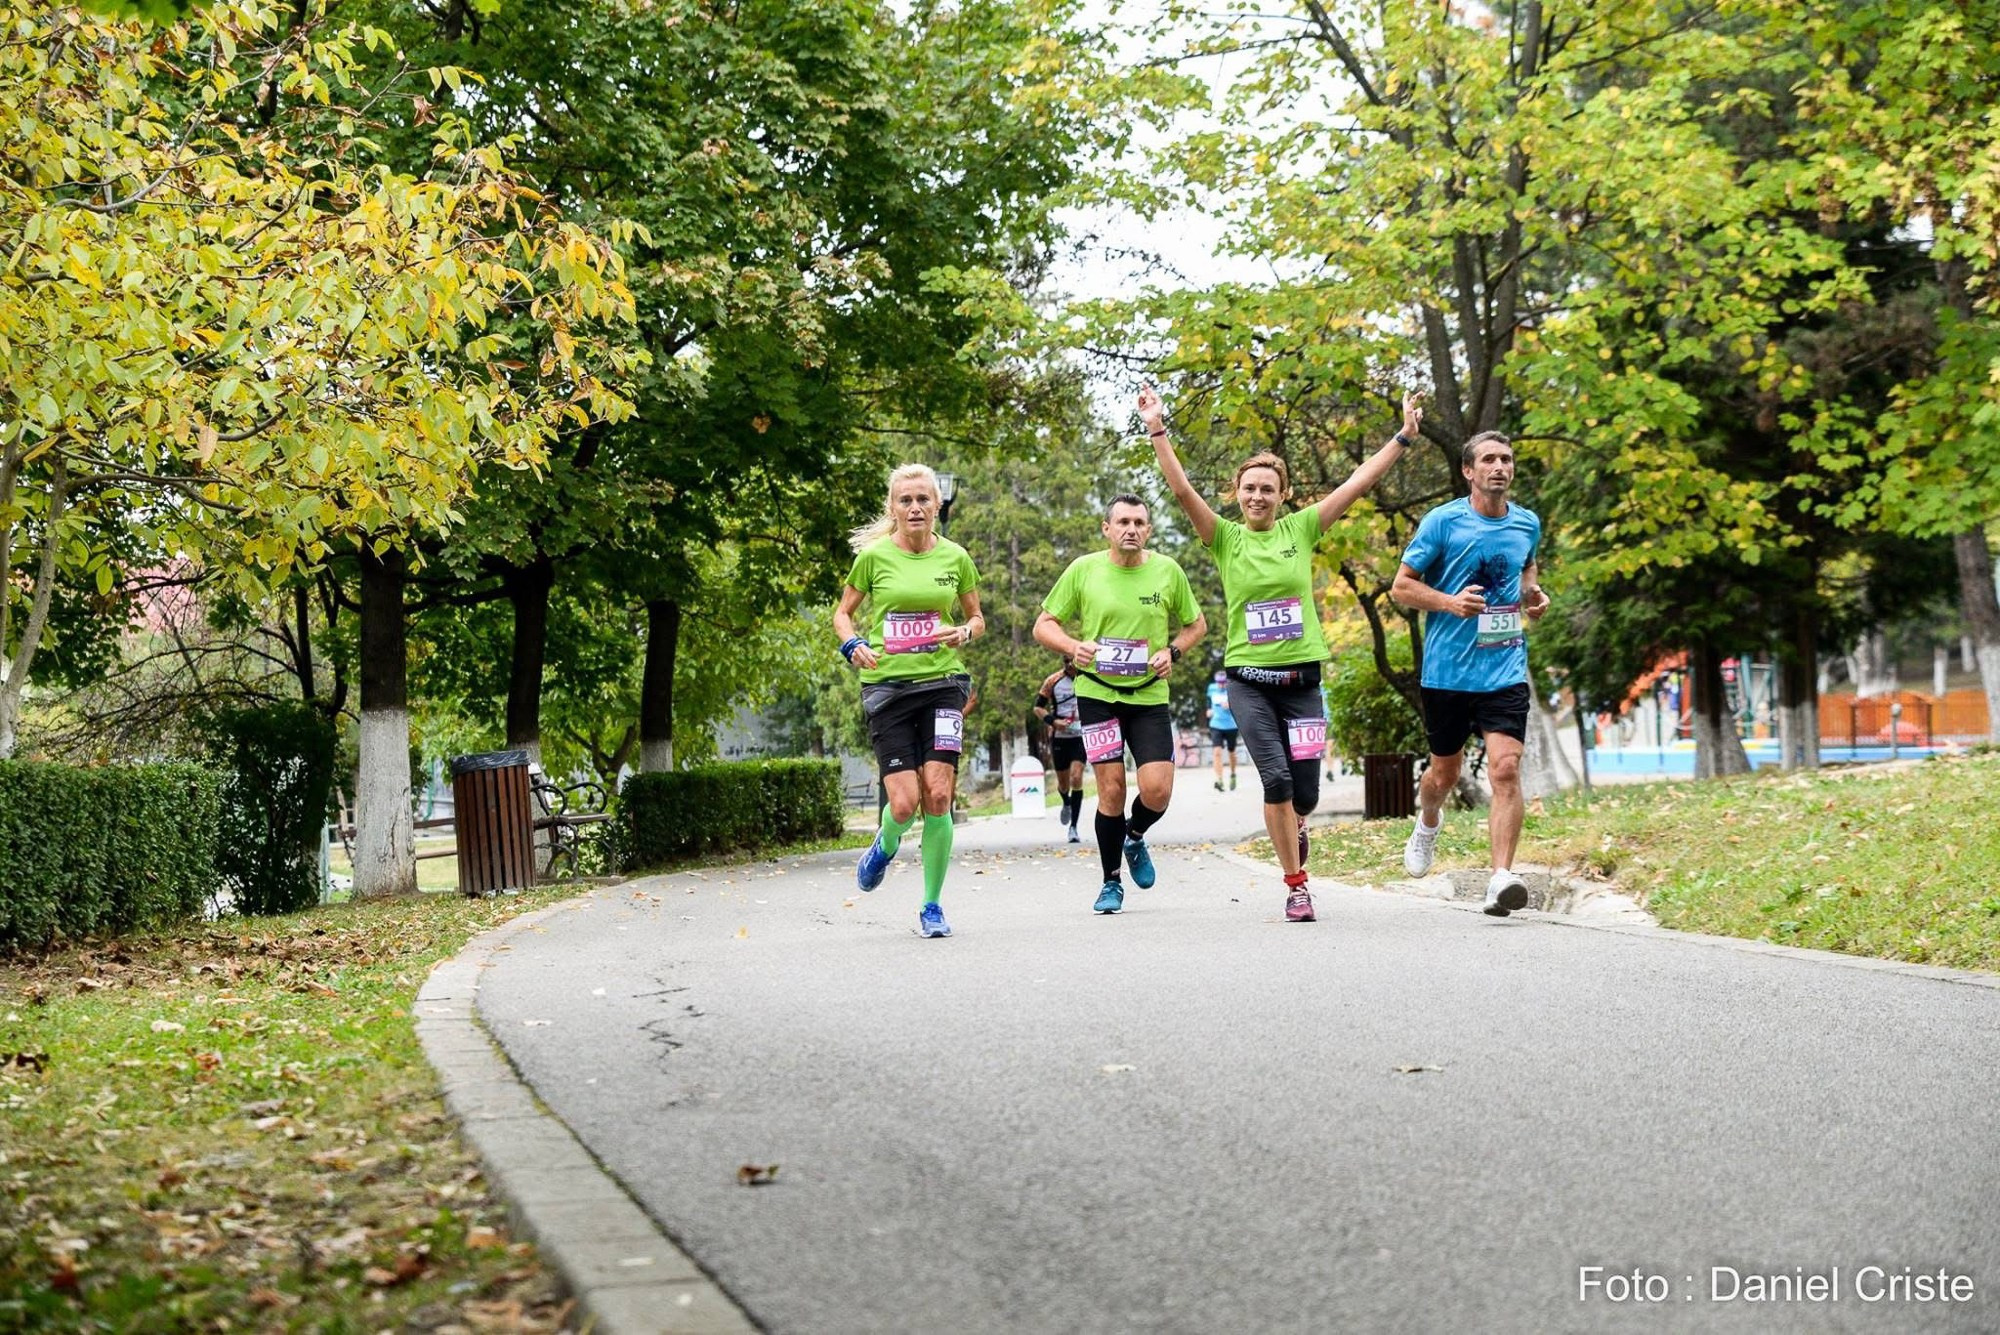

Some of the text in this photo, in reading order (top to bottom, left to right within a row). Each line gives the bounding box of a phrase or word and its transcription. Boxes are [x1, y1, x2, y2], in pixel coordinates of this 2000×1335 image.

[1257, 608, 1292, 627] 145
[1490, 614, 1516, 630] 551
[890, 621, 934, 637] 1009
[1112, 647, 1134, 662] 27
[953, 720, 963, 735] 9
[1296, 727, 1326, 742] 100
[1085, 729, 1116, 749] 1009
